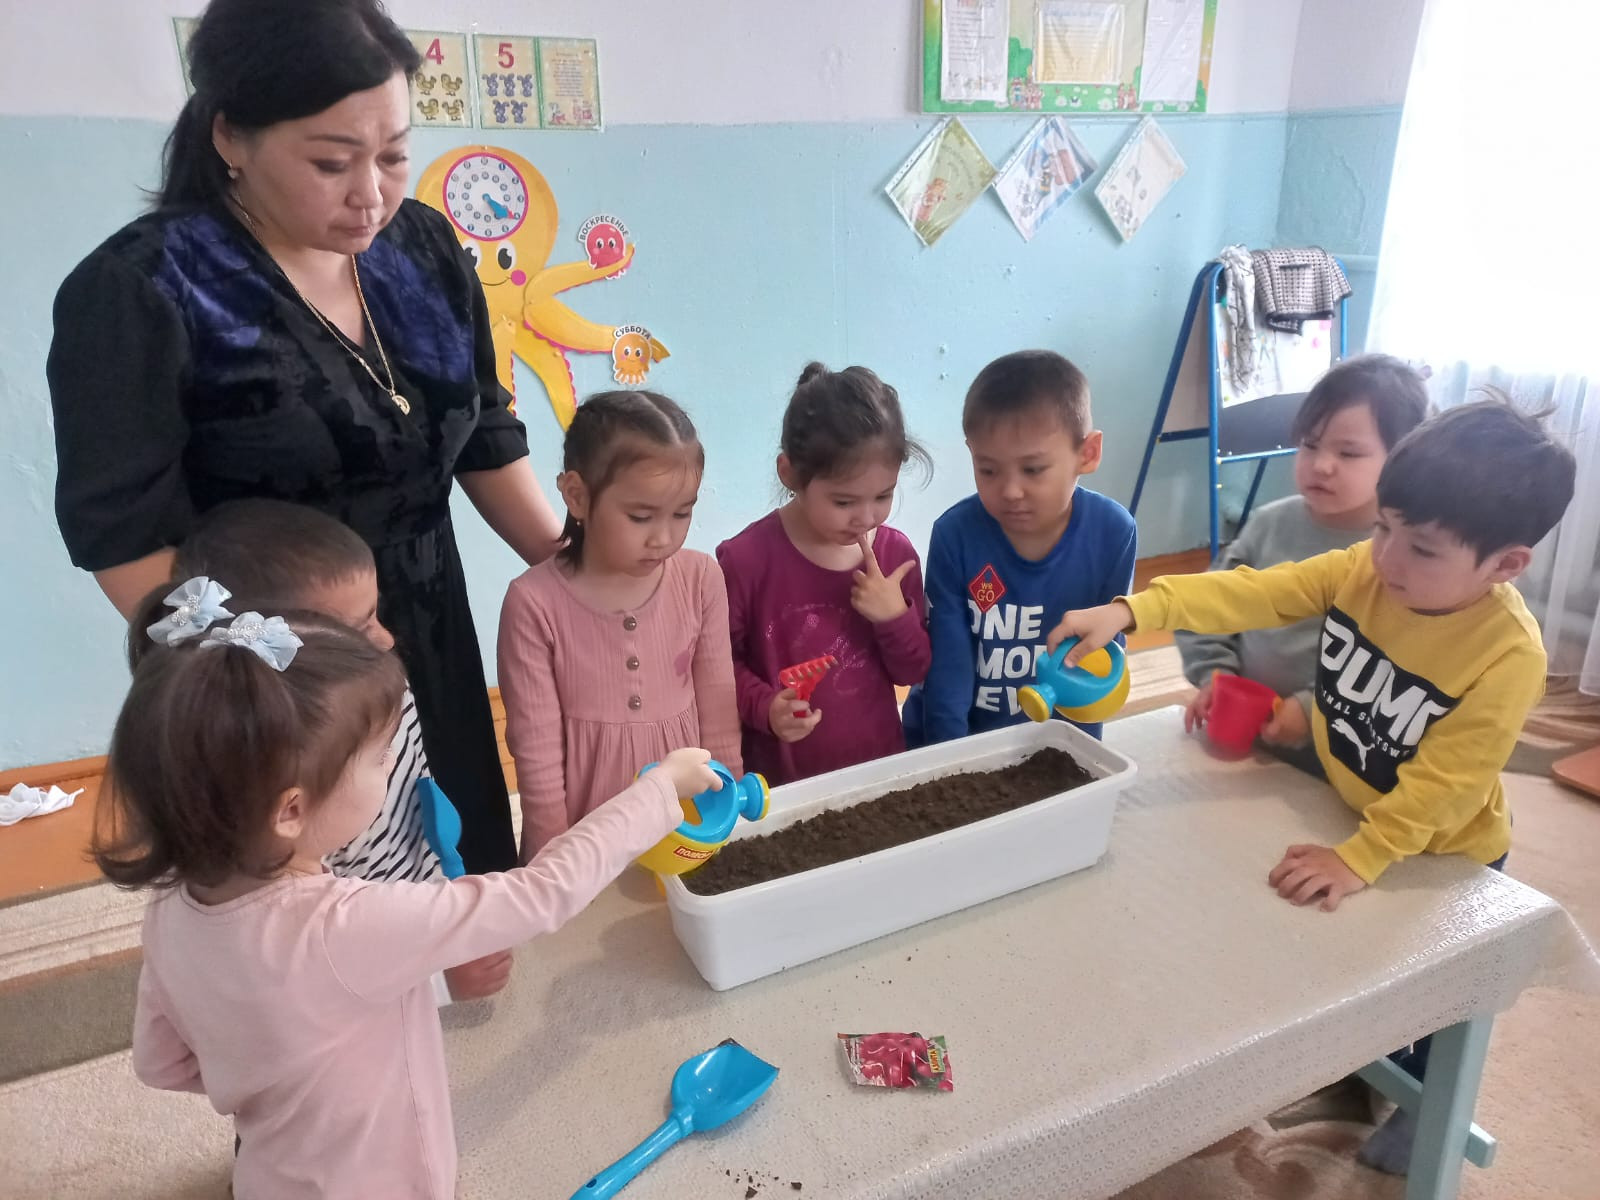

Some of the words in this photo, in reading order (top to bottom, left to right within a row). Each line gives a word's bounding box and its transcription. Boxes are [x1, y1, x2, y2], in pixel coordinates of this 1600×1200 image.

[426, 38, 444, 65] 4
[498, 43, 515, 69] 5
[579, 215, 629, 241] ВОСКРЕСЕНЬЕ
[615, 325, 651, 340] СУББОТА
[976, 589, 995, 602] GO
